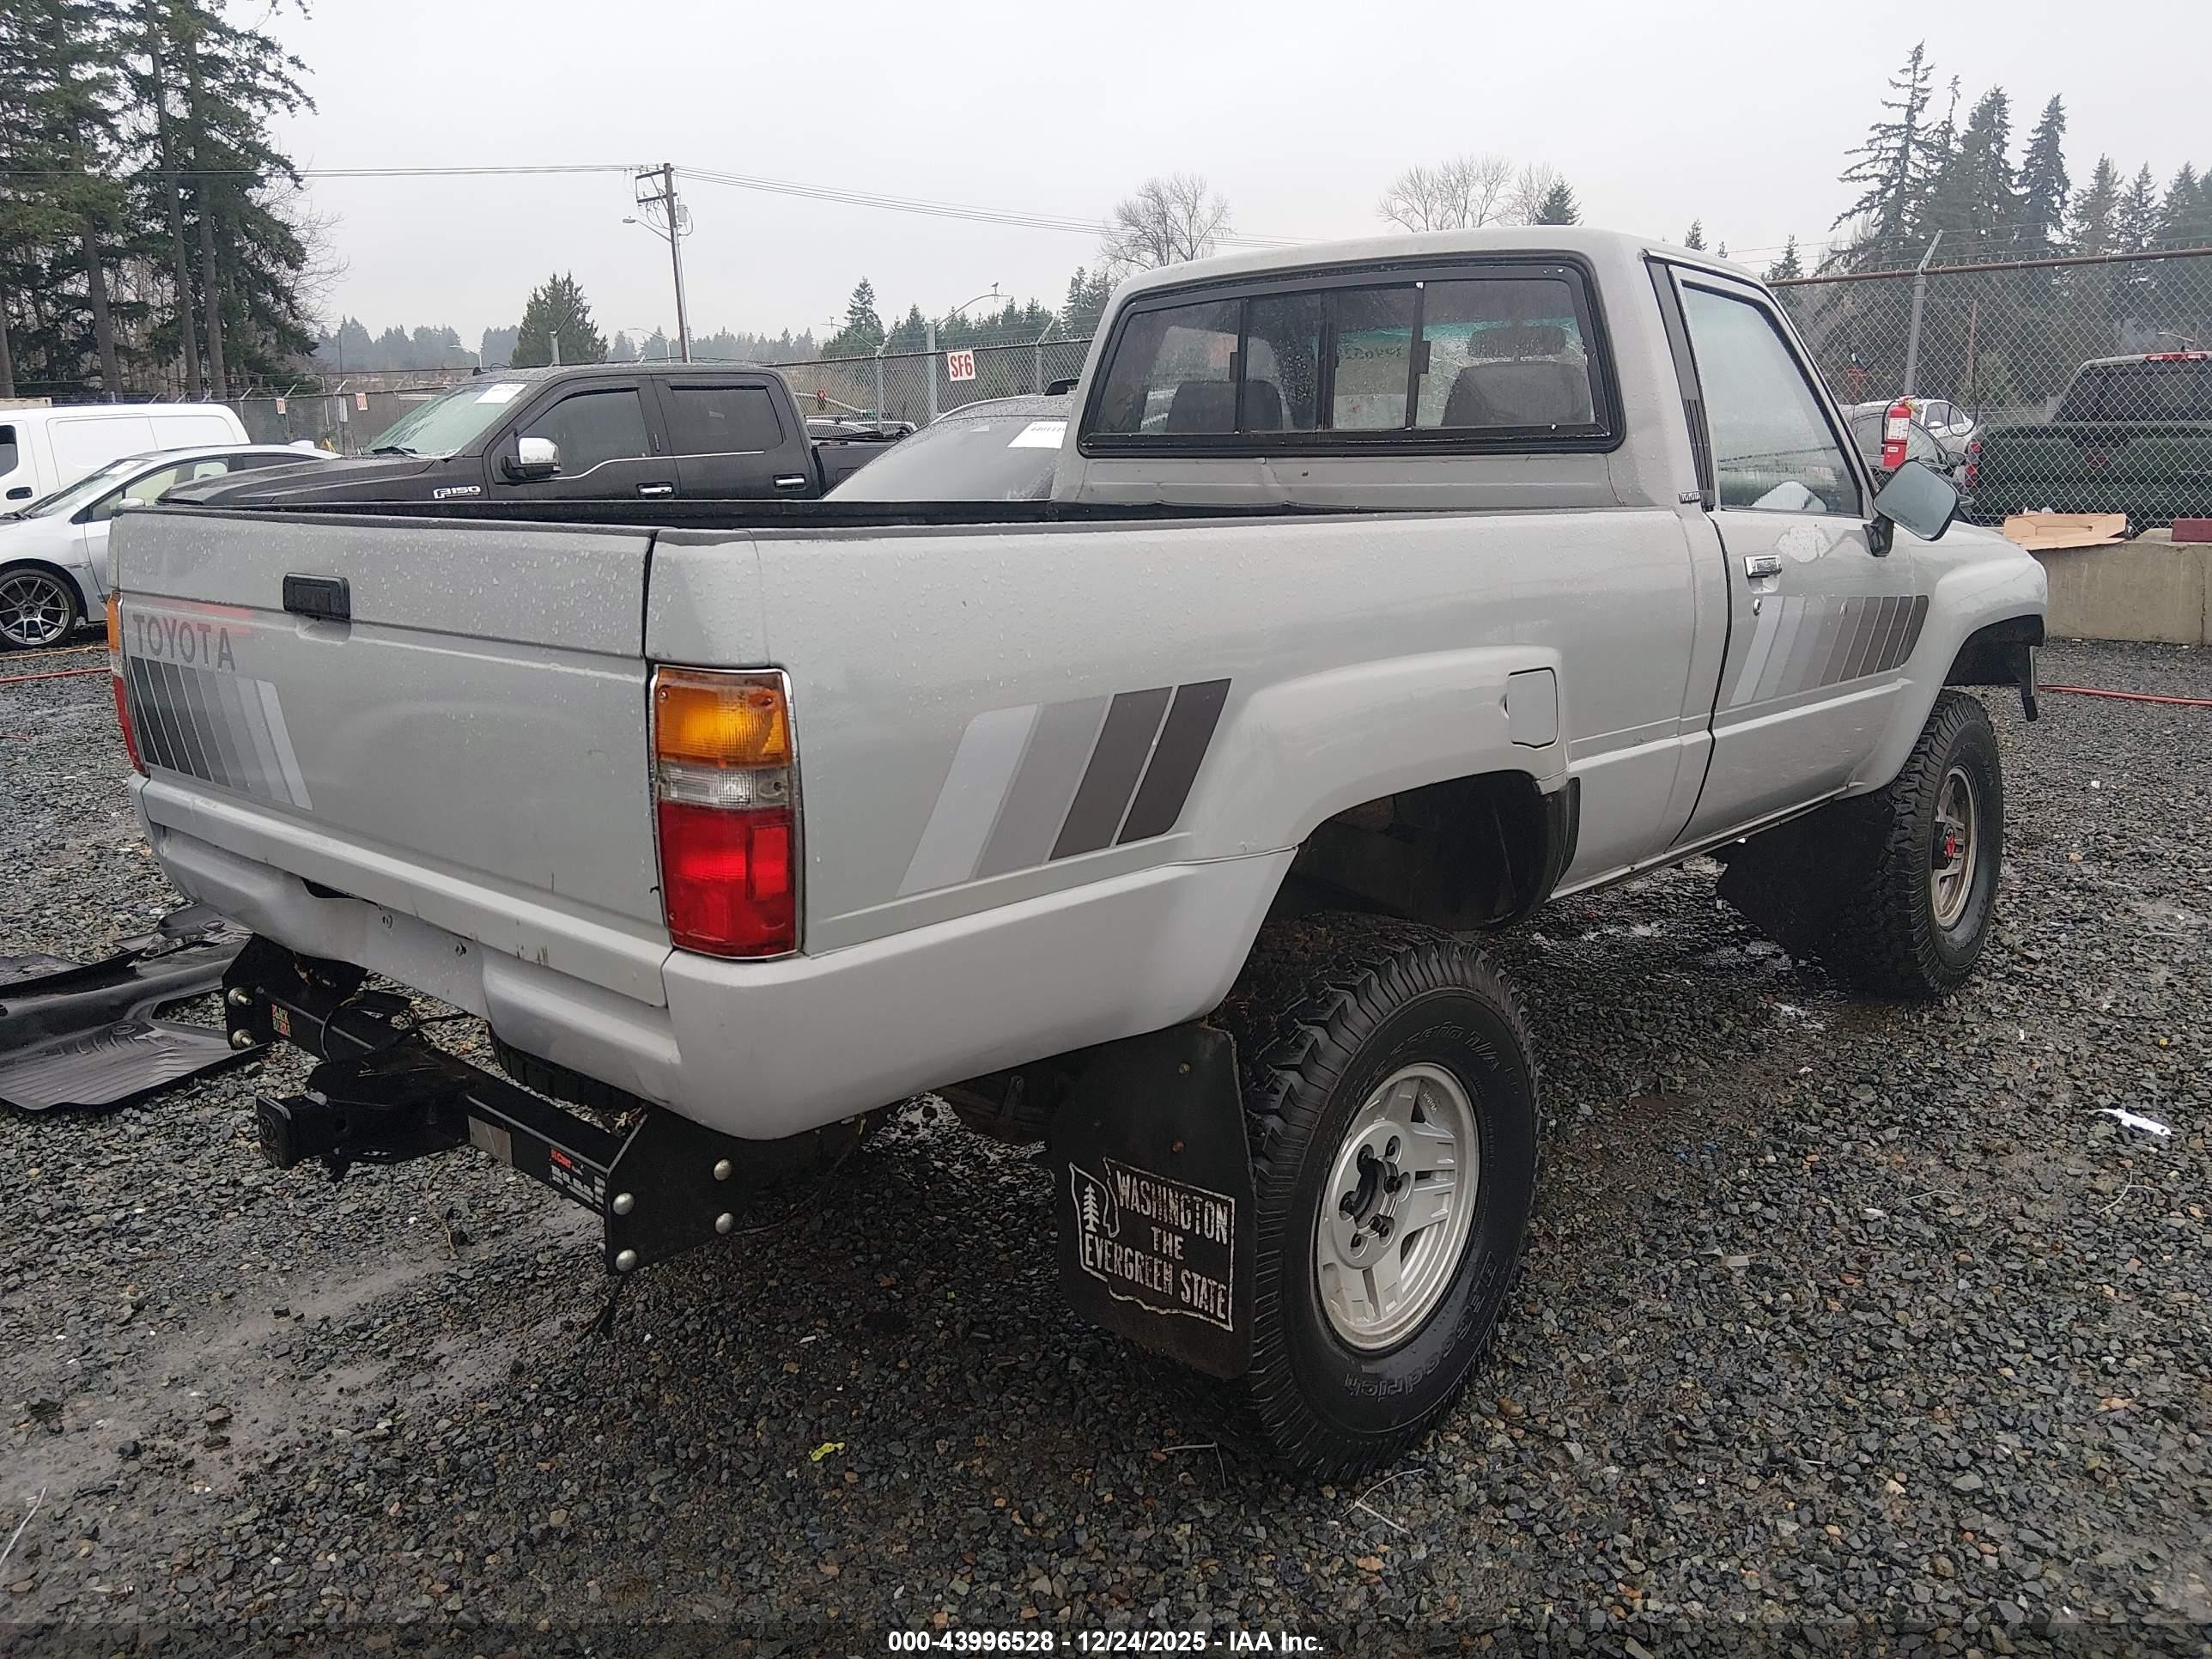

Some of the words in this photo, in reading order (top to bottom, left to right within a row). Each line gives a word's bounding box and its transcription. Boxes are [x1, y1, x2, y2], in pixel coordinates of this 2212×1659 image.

[950, 354, 973, 378] SF6
[132, 612, 235, 672] TOYOTA
[1116, 1170, 1228, 1245] WASHINGTON
[1151, 1225, 1184, 1260] THE
[1085, 1232, 1174, 1296] EVERGREEN
[1181, 1268, 1227, 1320] STATE
